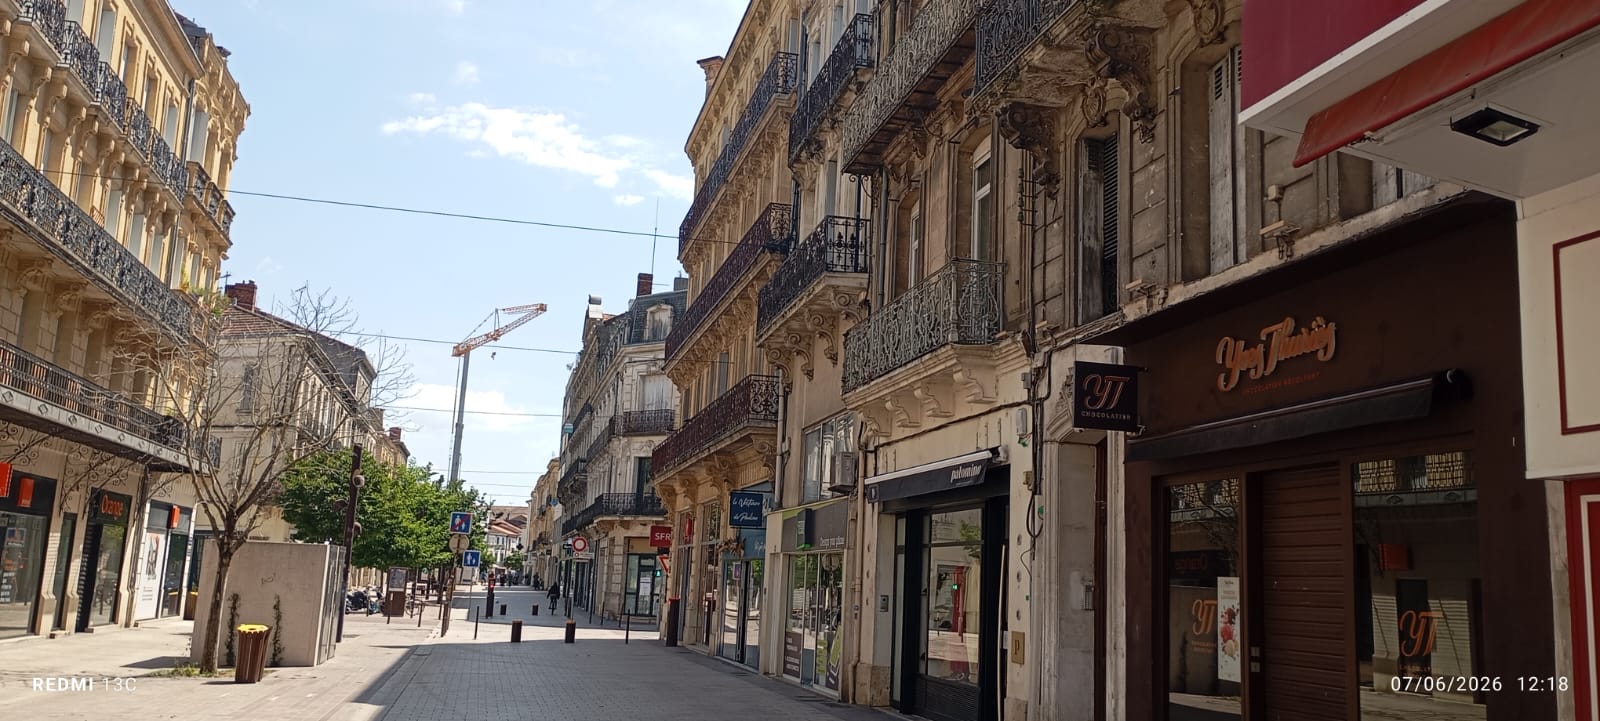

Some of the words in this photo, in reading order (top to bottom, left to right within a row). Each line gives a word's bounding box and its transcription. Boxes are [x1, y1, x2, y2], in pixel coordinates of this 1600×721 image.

[1215, 336, 1265, 391] Yves
[1081, 410, 1131, 420] CHOCOLATIER
[102, 494, 124, 520] Orange
[655, 532, 671, 541] SFR
